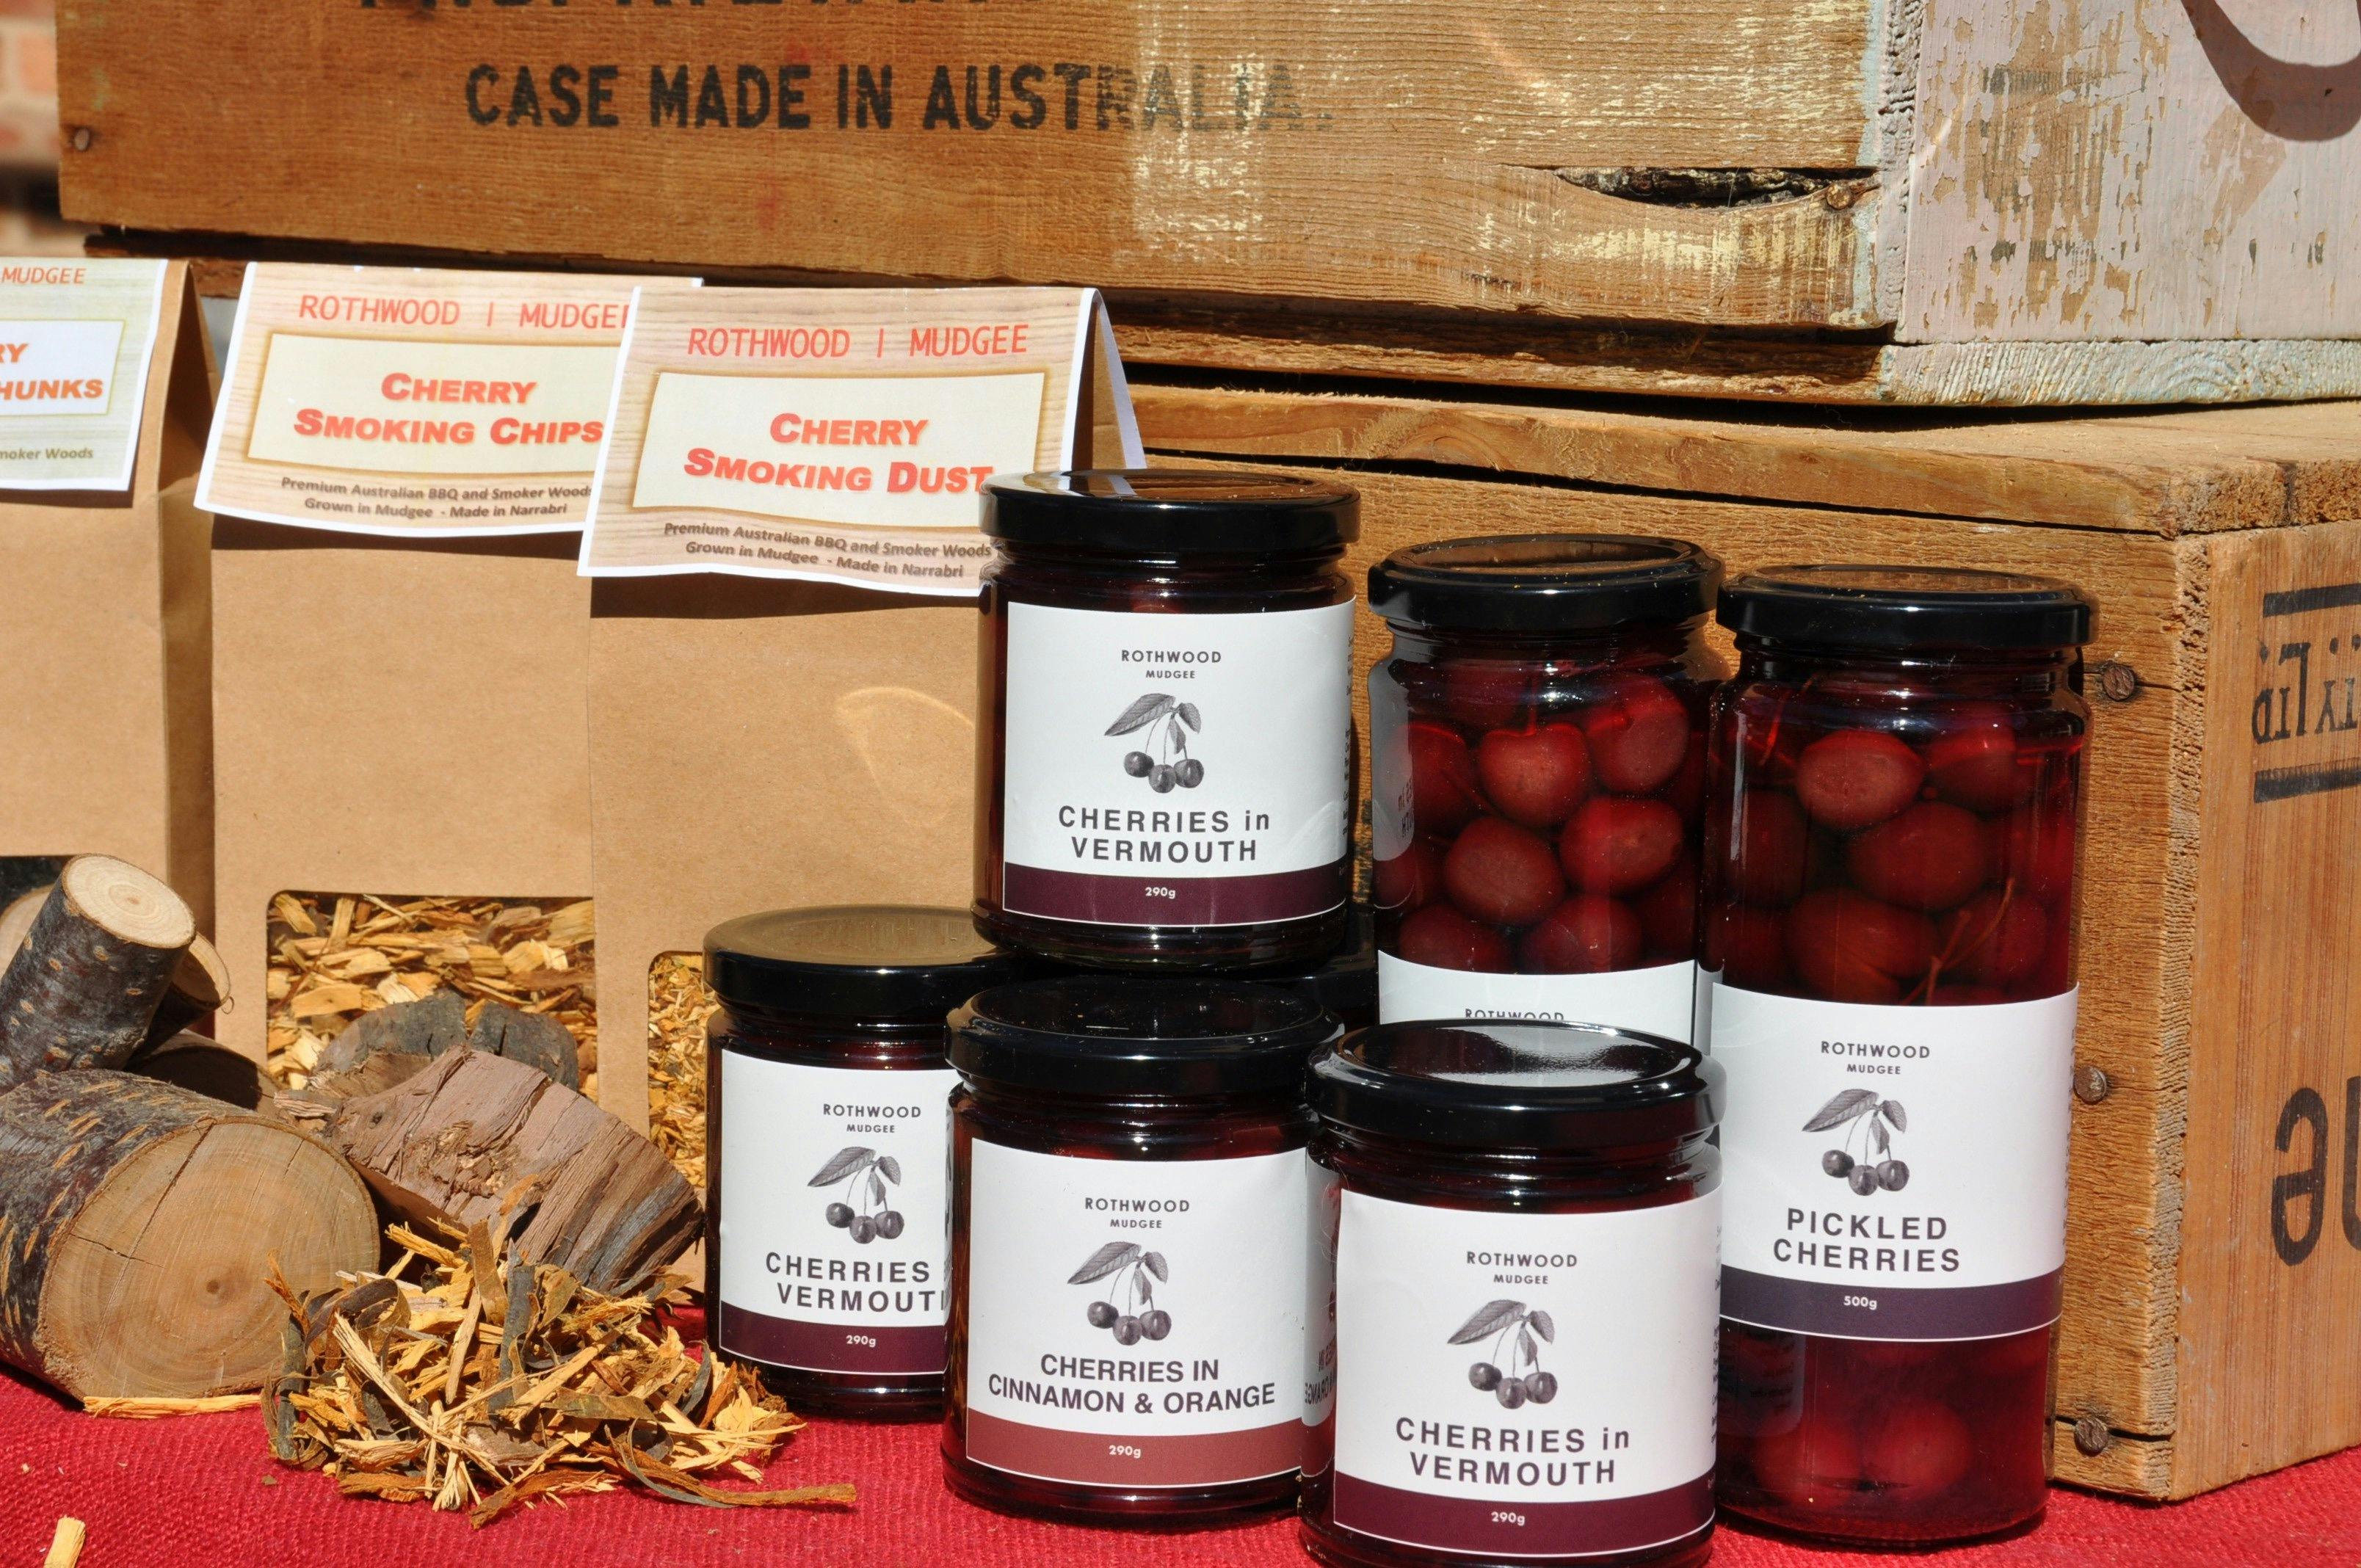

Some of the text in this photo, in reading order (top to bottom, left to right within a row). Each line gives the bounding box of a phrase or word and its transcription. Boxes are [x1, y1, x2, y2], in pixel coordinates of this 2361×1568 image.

[465, 64, 619, 126] CASE
[650, 64, 810, 128] MADE
[837, 64, 893, 129] IN
[1, 267, 87, 284] MUDGEE
[298, 294, 460, 325] ROTHWOOD
[687, 328, 851, 357] ROTHWOOD
[909, 324, 1029, 357] MUDGEE
[381, 372, 537, 404] CHERRY
[293, 408, 603, 445] SMOKING CHIPS
[770, 413, 929, 446] CHERRY
[46, 447, 93, 459] Woods
[683, 448, 871, 490] SMOKING
[280, 476, 347, 495] Premium
[350, 484, 424, 499] Australian
[429, 488, 458, 500] BBQ
[461, 489, 490, 500] and
[491, 489, 544, 501] Smoker
[304, 497, 353, 515] Grown
[357, 504, 371, 515] in
[374, 506, 433, 518] Mudgee
[449, 505, 489, 517] Made
[493, 504, 506, 517] in
[509, 502, 567, 516] Narrabri
[664, 523, 992, 557] Premium Australian BBQ and Smoker Woods
[685, 542, 736, 556] Grown
[738, 545, 752, 557] in
[757, 548, 819, 565] Mudgee
[836, 557, 880, 573] Made
[883, 564, 898, 576] in
[902, 565, 964, 578] Narrabri
[1121, 650, 1222, 664] ROTHWOOD
[1145, 670, 1196, 679] MUDGEE
[1058, 805, 1270, 833] CHERRIES in
[1071, 837, 1257, 863] VERMOUTH
[1145, 887, 1176, 899] 290g
[1821, 1041, 1930, 1059] ROTHWOOD
[1846, 1064, 1901, 1075] MUDGEE
[823, 1104, 921, 1118] ROTHWOOD
[846, 1124, 896, 1133] MUDGEE
[1084, 1197, 1190, 1213] ROTHWOOD
[1110, 1219, 1162, 1229] MUDGEE
[1787, 1208, 1948, 1240] PICKLED
[766, 1252, 930, 1283] CHERRIES
[1466, 1252, 1578, 1268] ROTHWOOD
[1773, 1238, 1960, 1273] CHERRIES
[1493, 1274, 1549, 1285] MUDGEE
[777, 1282, 945, 1313] VERMOUT
[1843, 1295, 1877, 1310] 500g
[846, 1335, 877, 1348] 290g
[1040, 1354, 1219, 1382] CHERRIES IN
[988, 1373, 1276, 1414] CINNAMON & ORANGE
[1396, 1417, 1629, 1453] CHERRIES in
[1109, 1445, 1142, 1459] 290g
[1410, 1452, 1615, 1486] VERMOUTH
[1491, 1511, 1526, 1525] 290g
